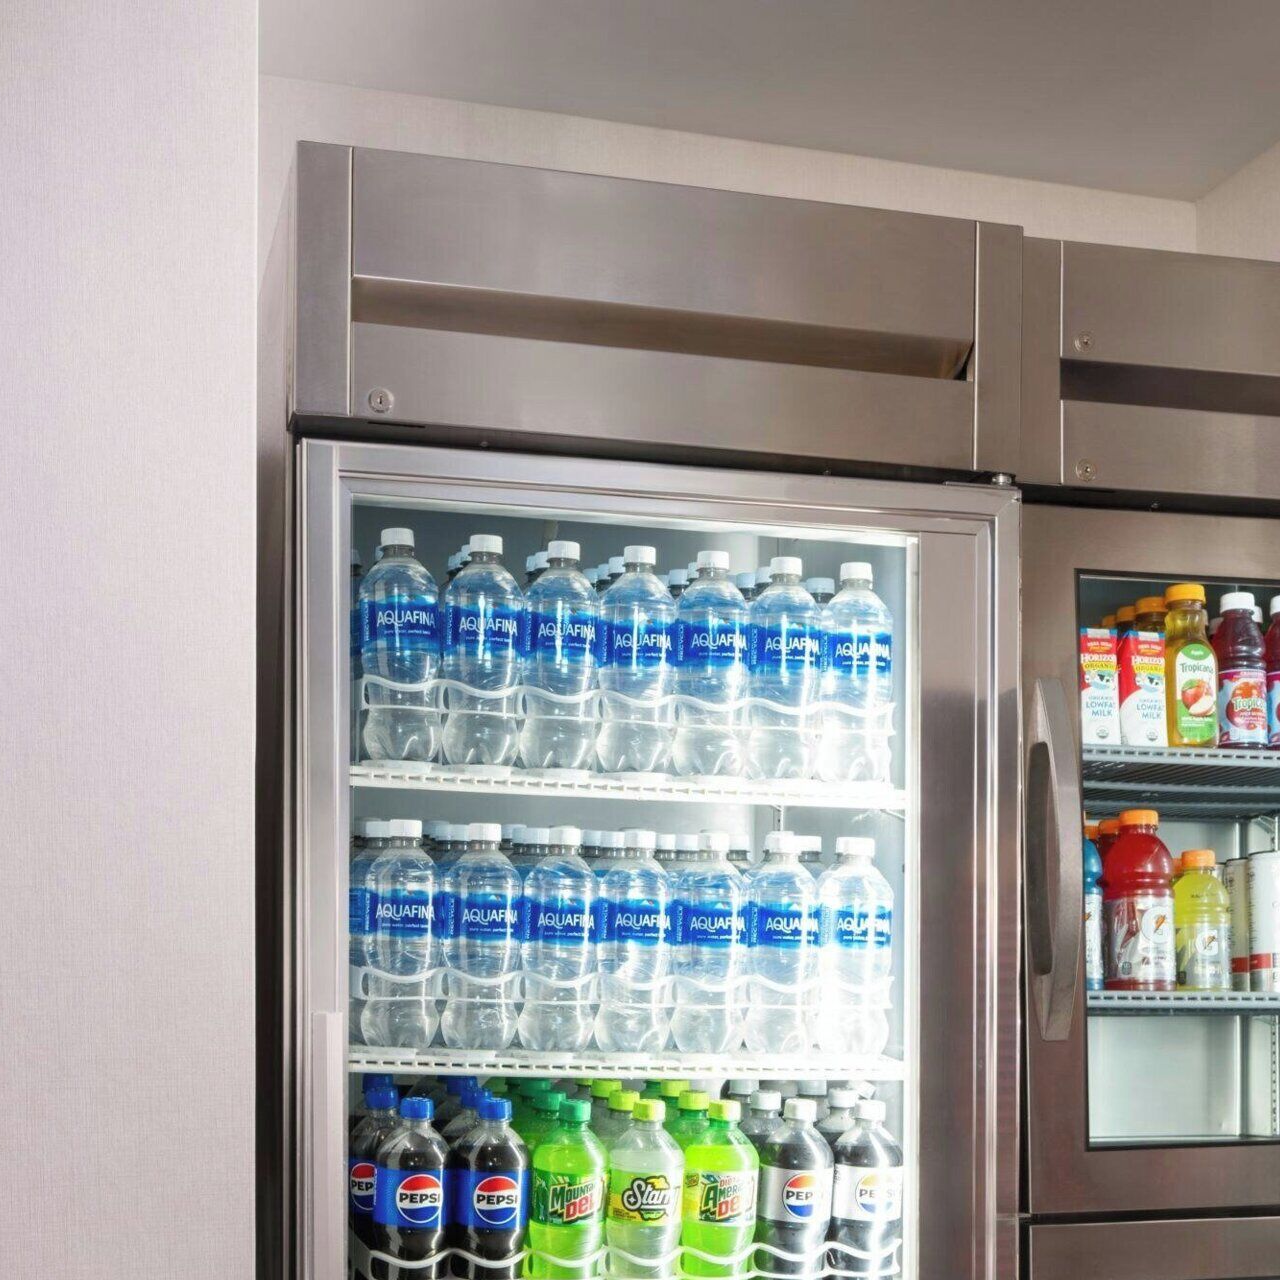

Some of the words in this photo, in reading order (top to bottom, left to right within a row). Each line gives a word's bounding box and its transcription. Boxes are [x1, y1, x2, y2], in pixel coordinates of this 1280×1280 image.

[377, 610, 435, 627] AQUAFINA
[459, 616, 518, 637] AQUAFINA
[538, 622, 596, 641] AQUAFINA
[1180, 662, 1214, 675] Tropicana
[1086, 701, 1114, 709] LOWFA
[1136, 703, 1163, 712] LOWFA
[1141, 711, 1162, 719] MILK
[376, 903, 436, 921] AQUAFINA
[462, 908, 518, 926] AQUAFINA
[538, 912, 595, 930] AQUAFINA
[399, 1191, 441, 1205] PEPSI
[476, 1193, 518, 1206] PEPSI
